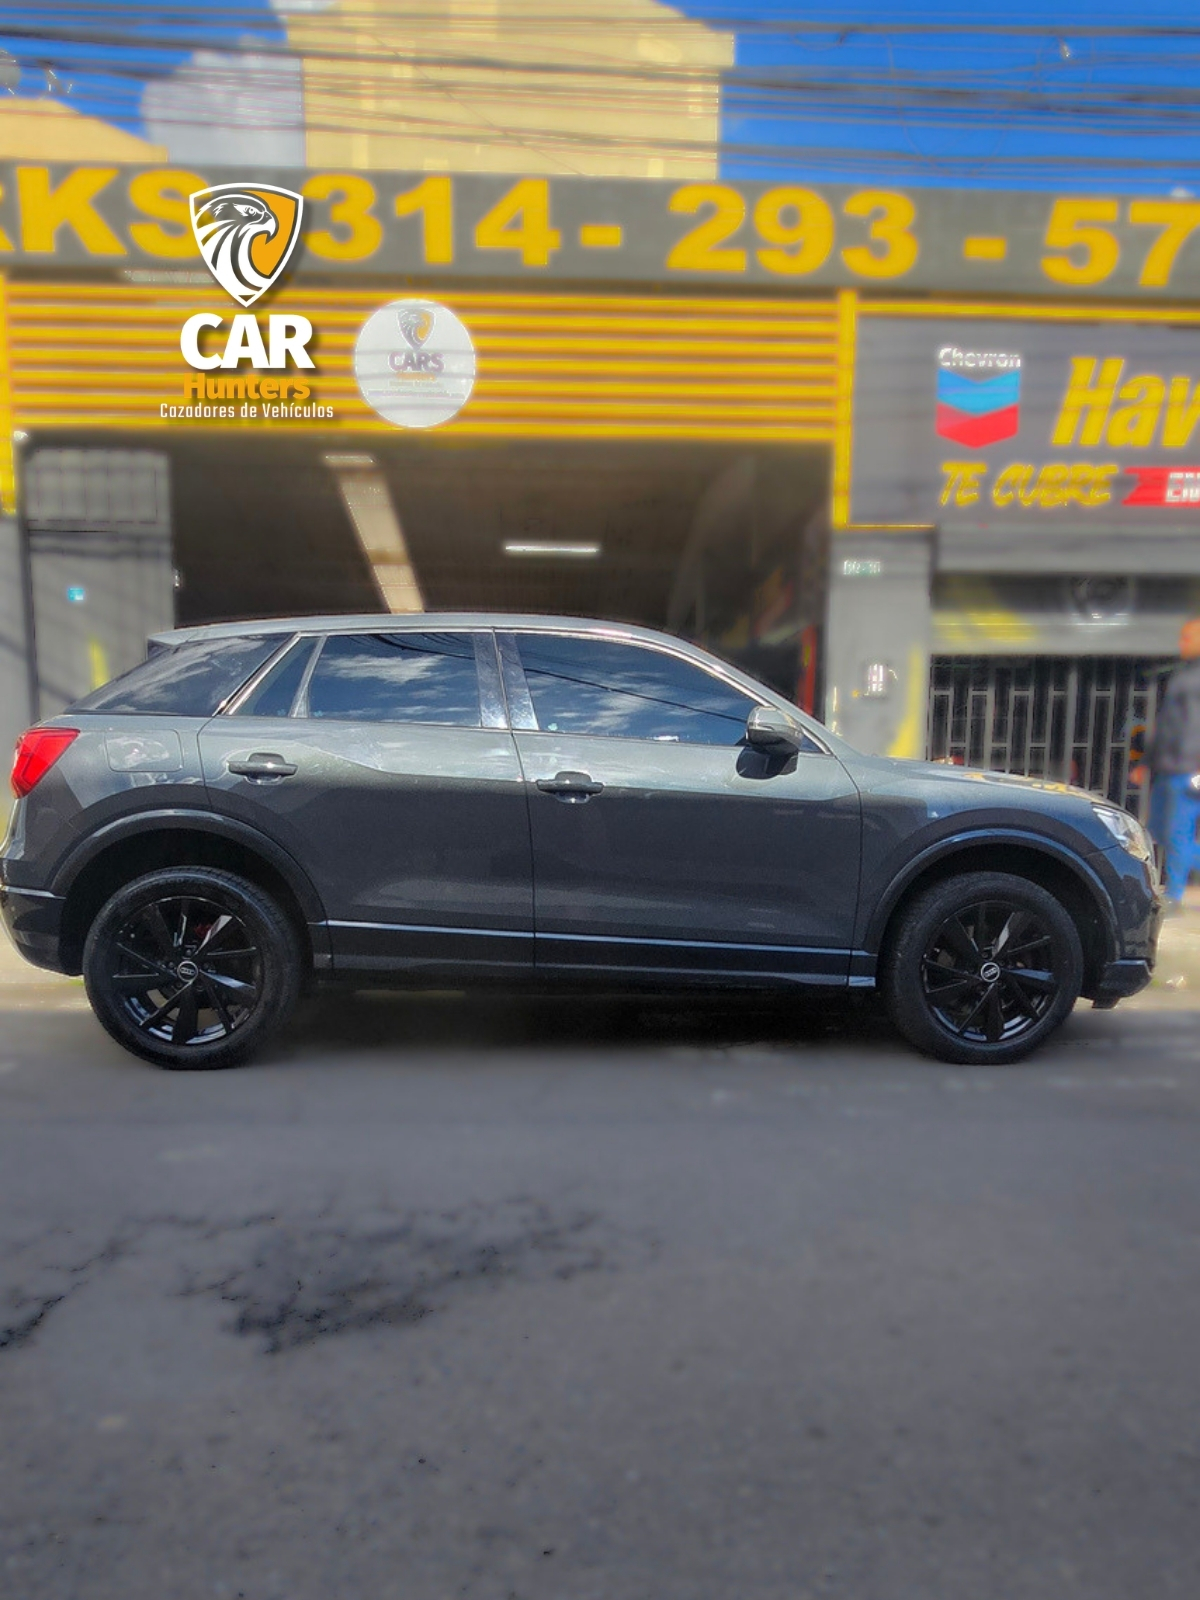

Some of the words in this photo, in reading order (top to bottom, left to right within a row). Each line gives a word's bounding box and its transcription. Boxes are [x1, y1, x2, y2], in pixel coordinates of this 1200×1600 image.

[666, 184, 919, 278] 293
[1041, 199, 1200, 286] 57
[388, 351, 445, 373] CARS
[939, 348, 1021, 368] Chevron
[940, 462, 987, 507] TE
[992, 463, 1119, 508] CUBRE
